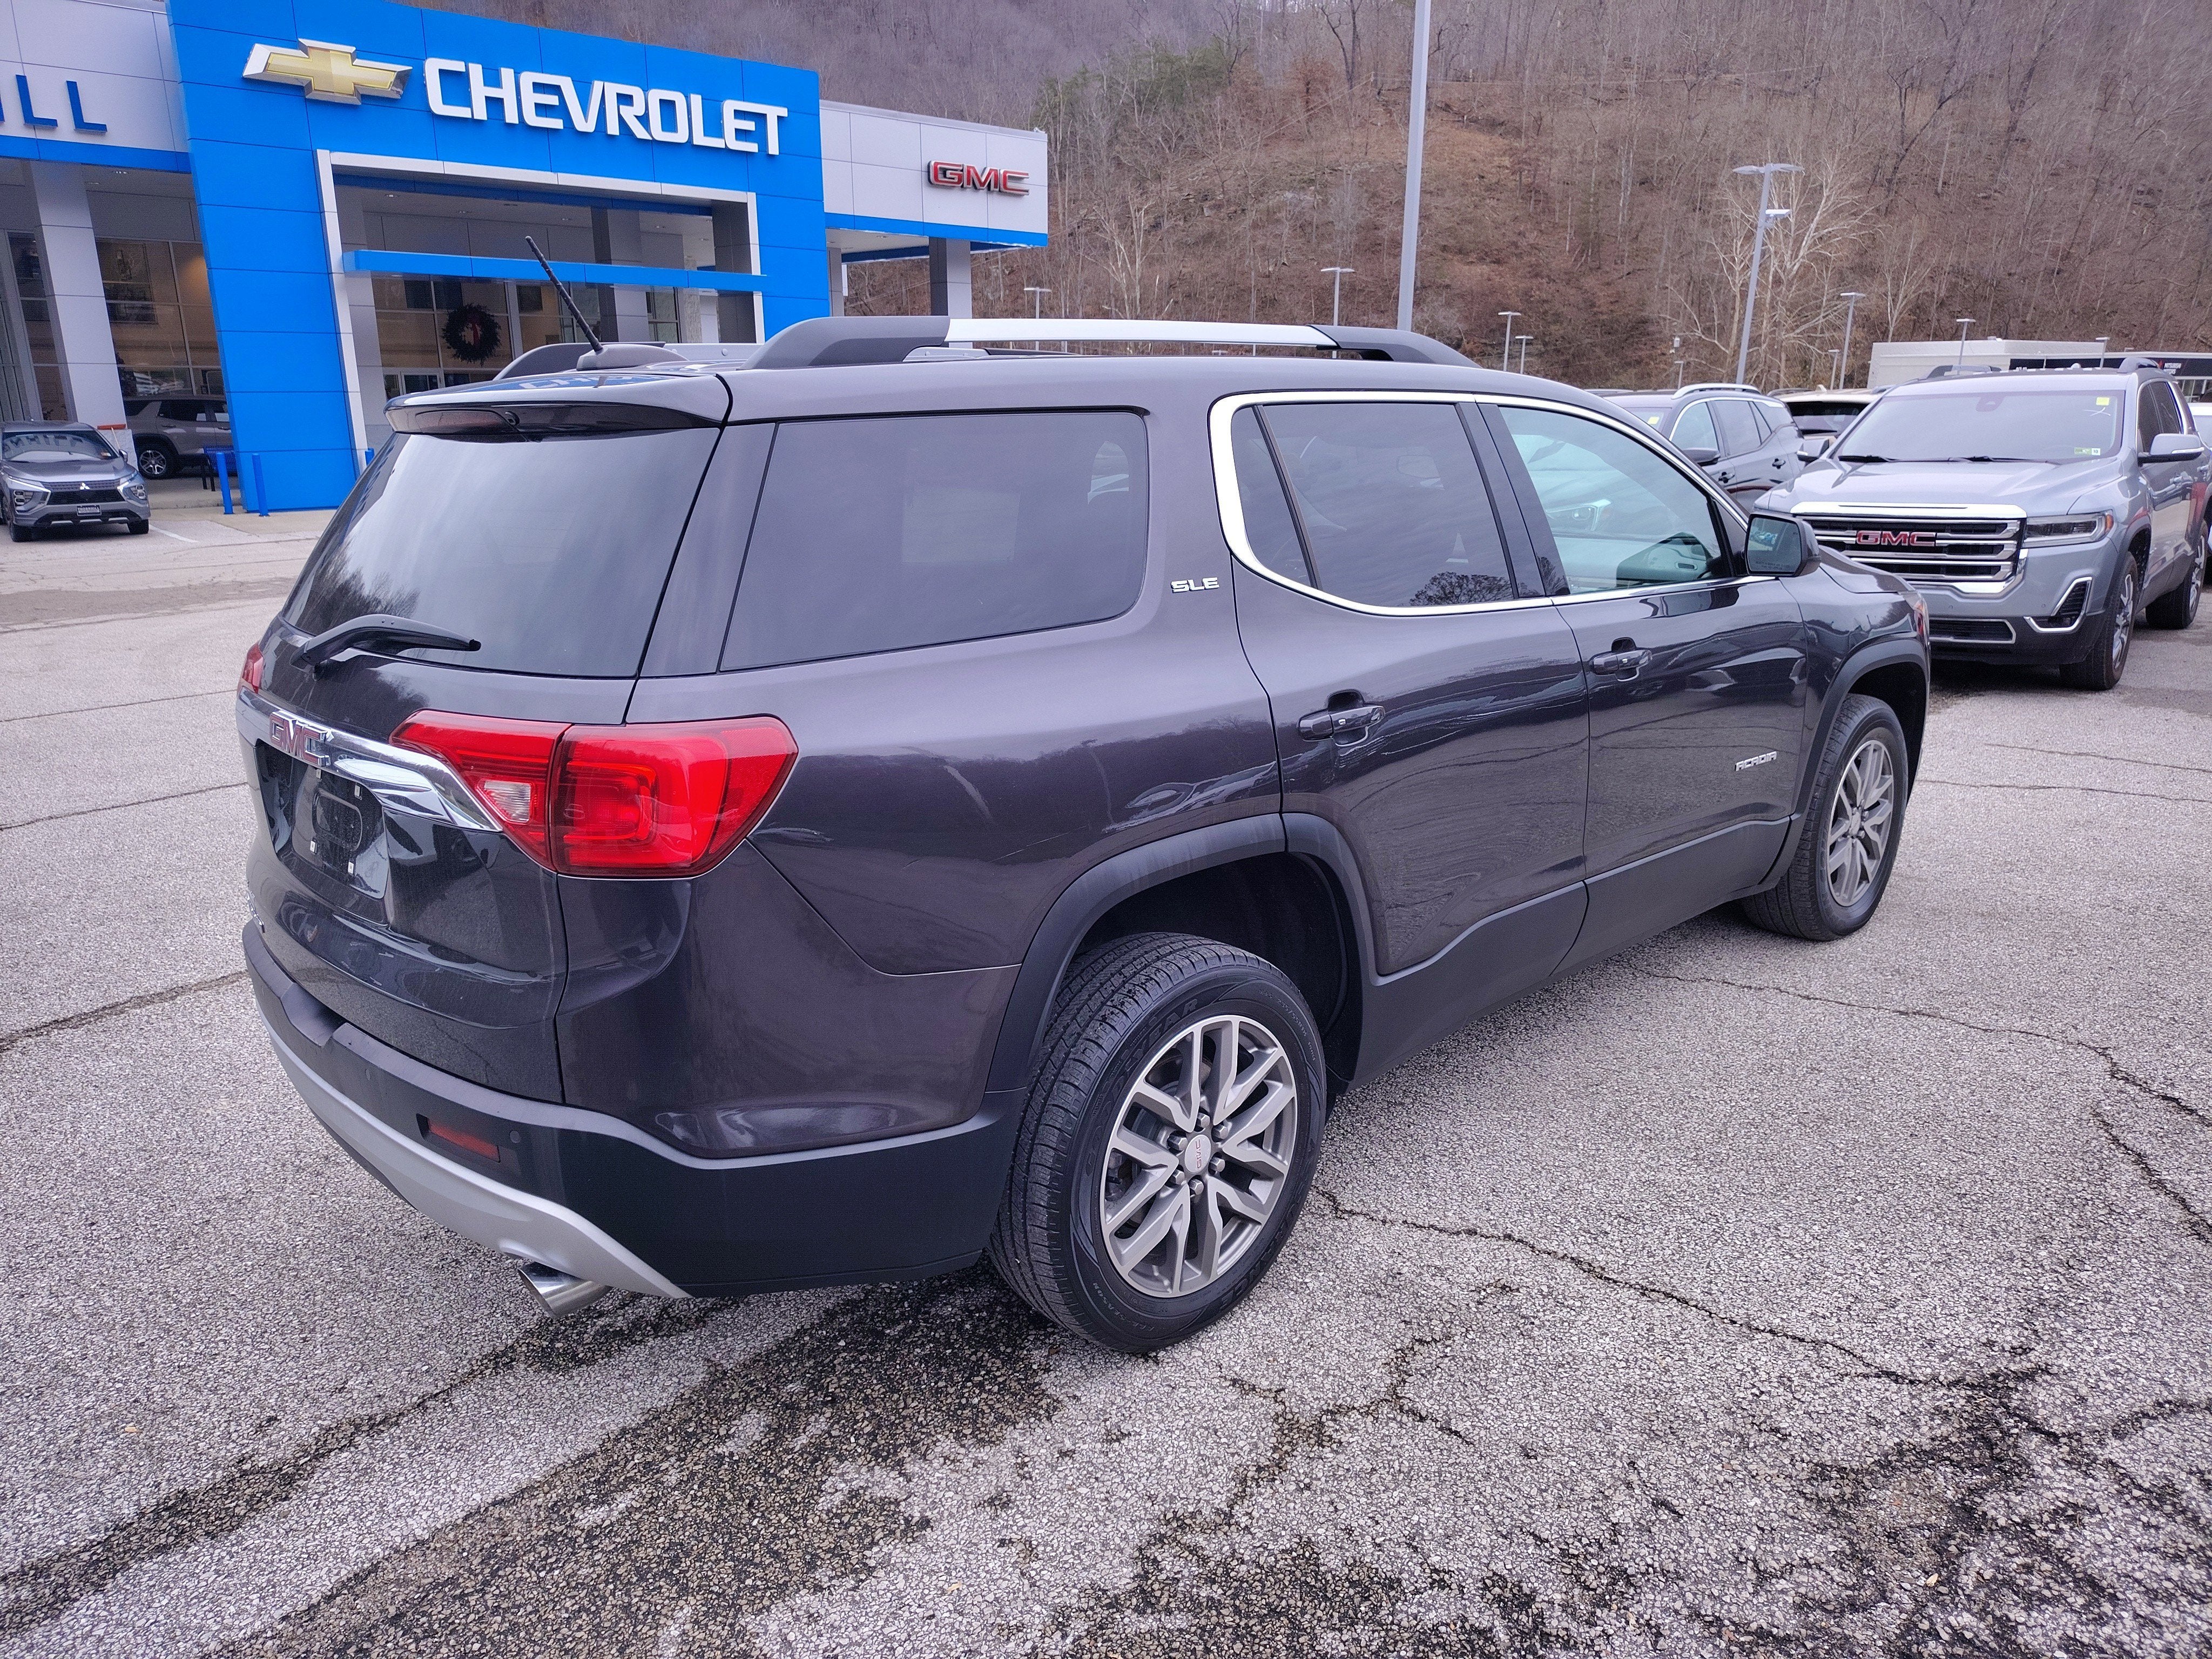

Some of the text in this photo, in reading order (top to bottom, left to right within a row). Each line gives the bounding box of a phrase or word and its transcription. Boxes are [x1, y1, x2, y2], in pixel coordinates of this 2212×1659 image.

[0, 75, 107, 132] LL
[424, 57, 788, 155] CHEVROLET
[927, 160, 1029, 195] GMC
[1856, 530, 1936, 547] GMC
[1171, 577, 1219, 593] SLE
[270, 711, 331, 767] GMC
[1735, 751, 1777, 771] ACADIA
